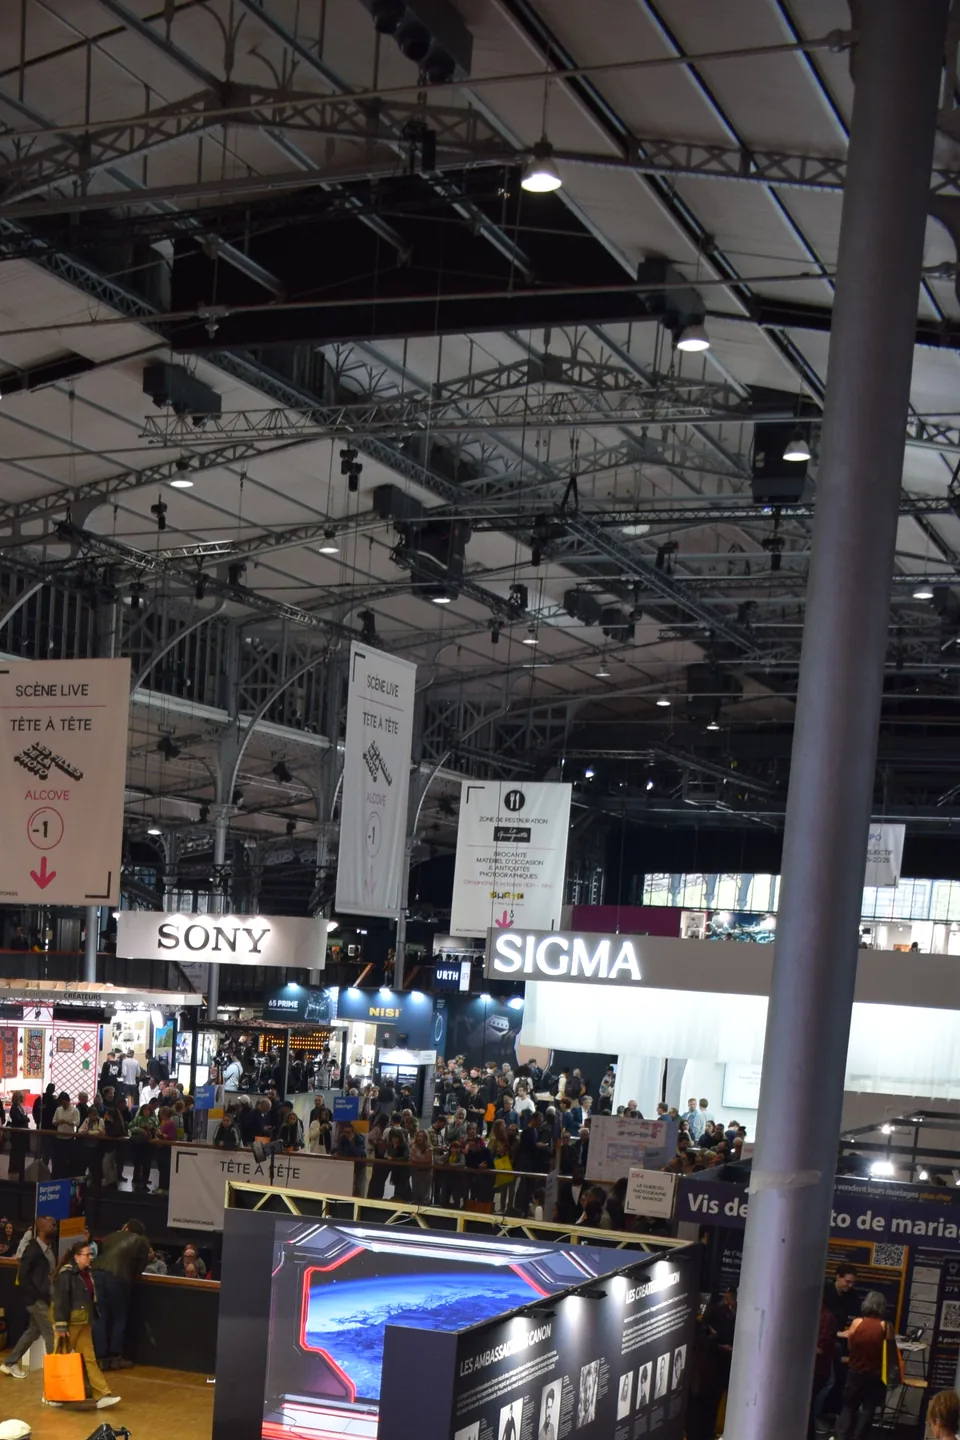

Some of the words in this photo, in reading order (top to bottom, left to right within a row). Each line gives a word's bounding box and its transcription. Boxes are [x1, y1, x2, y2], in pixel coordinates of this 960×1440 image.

[15, 681, 57, 697] SCÈNE
[60, 684, 89, 697] LIVE
[10, 716, 42, 731] TÊTE
[45, 716, 55, 731] À
[59, 716, 92, 731] TÊTE
[25, 790, 70, 801] ALCOVE
[32, 821, 48, 838] -1
[157, 923, 271, 954] SONY
[493, 934, 642, 981] SIGMA
[436, 970, 459, 981] URTH
[277, 1000, 299, 1008] PRIME
[220, 1159, 251, 1175] TÊTE
[837, 1184, 867, 1192] vendent
[867, 1185, 885, 1195] leurs
[885, 1188, 919, 1199] mariages
[687, 1192, 719, 1214] Vis
[856, 1210, 885, 1232] de
[890, 1217, 960, 1242] maria
[459, 1357, 474, 1377] LES
[528, 1323, 552, 1346] CANON
